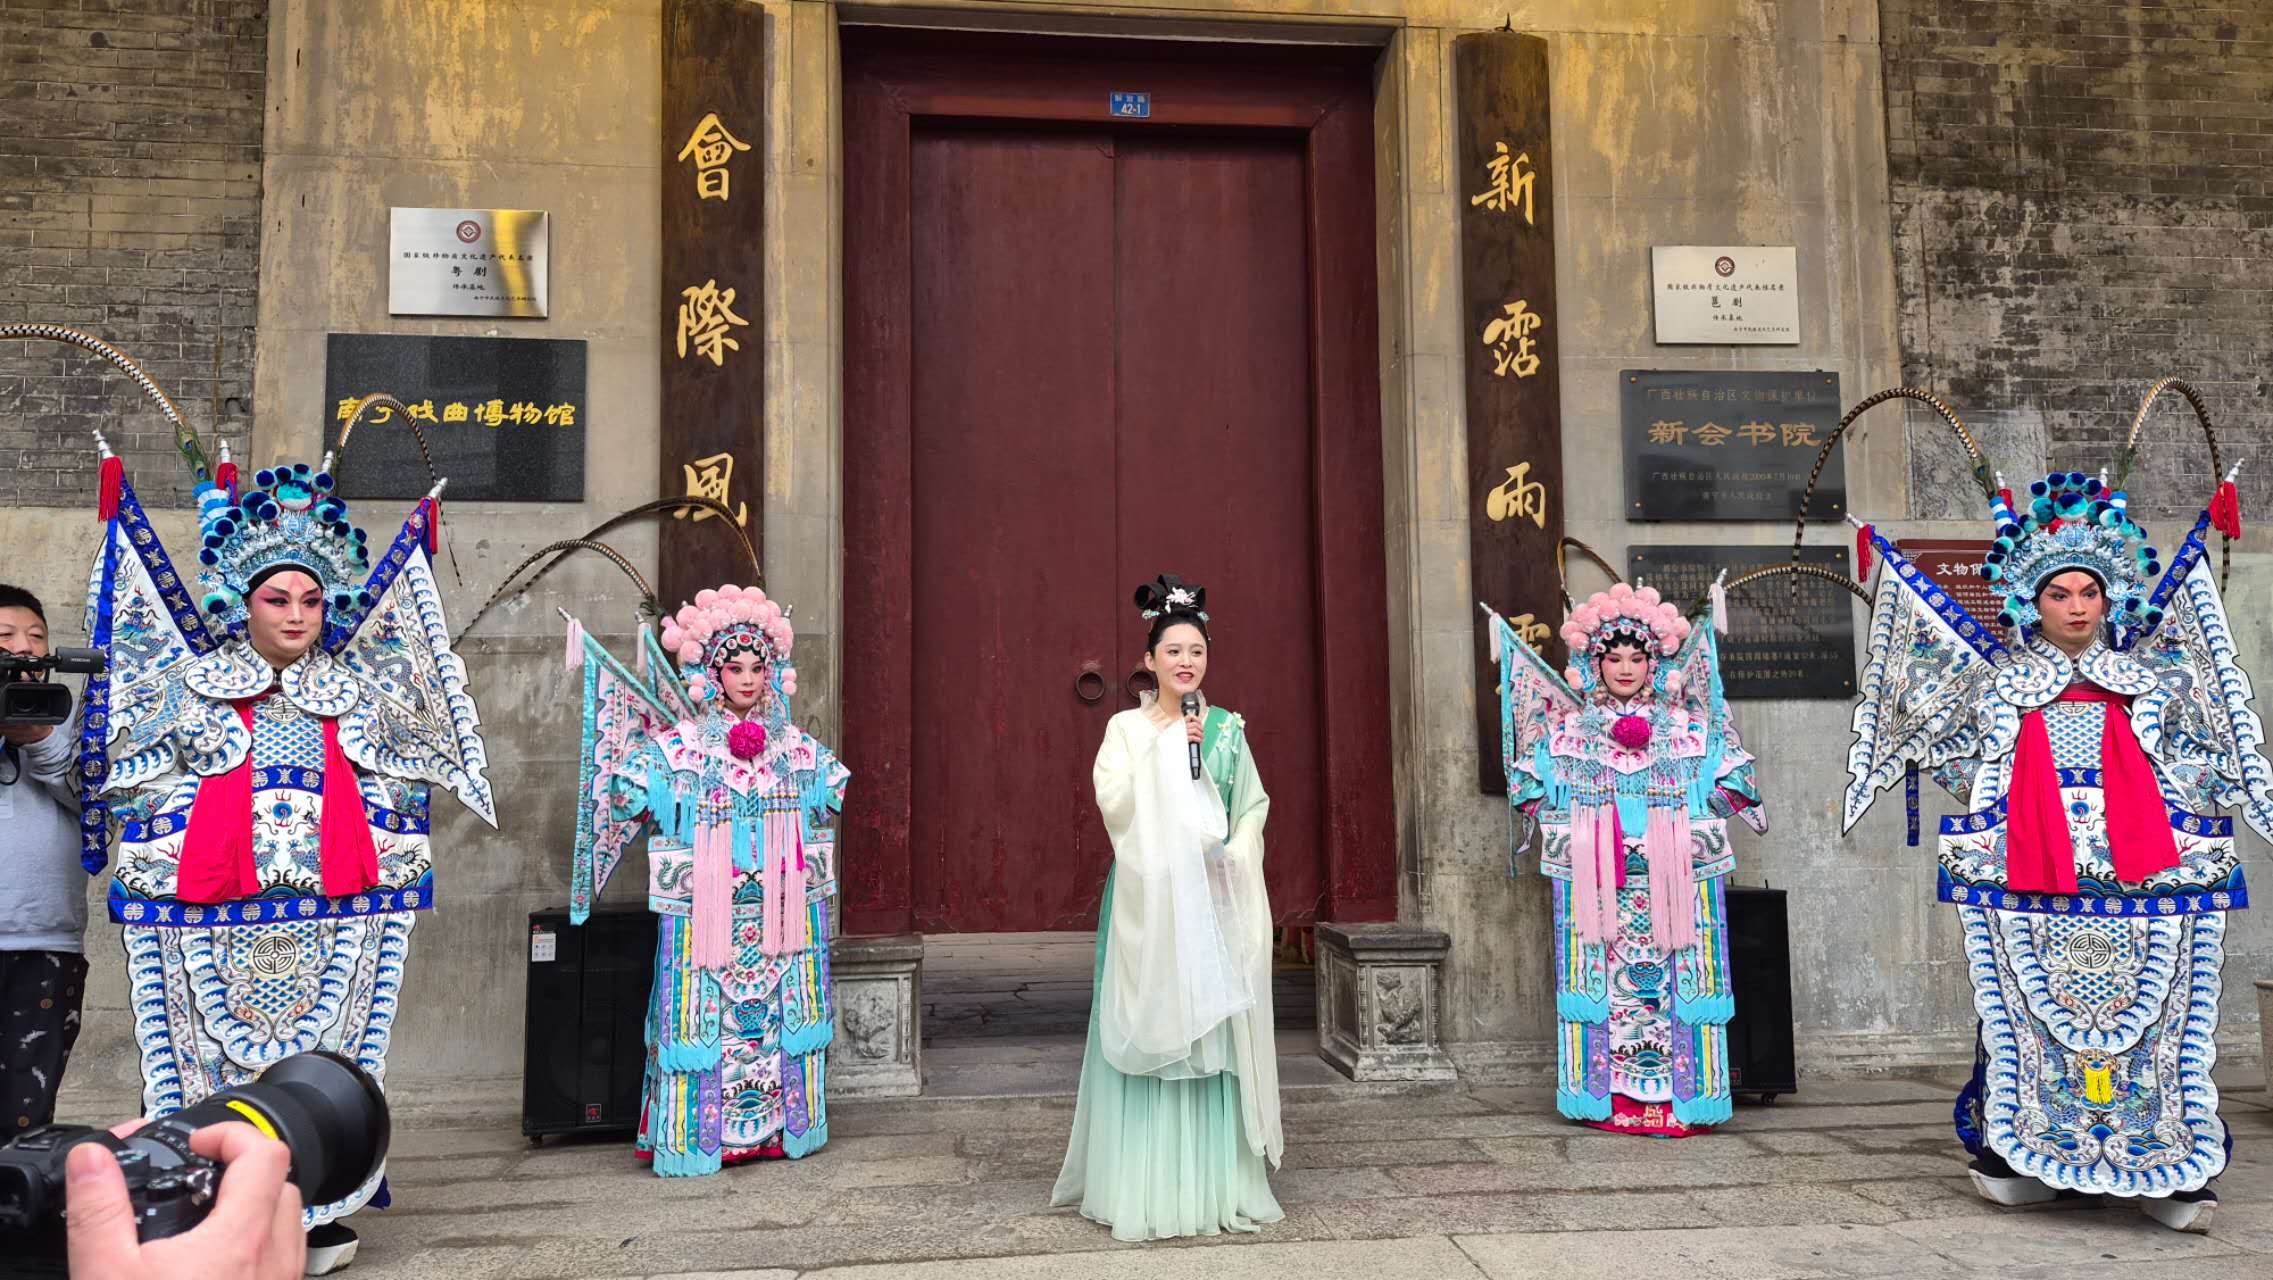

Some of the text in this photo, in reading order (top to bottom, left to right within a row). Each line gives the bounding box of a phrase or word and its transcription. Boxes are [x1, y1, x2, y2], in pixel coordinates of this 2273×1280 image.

[1121, 103, 1141, 115] 42-1
[450, 265, 488, 278] 粤剧
[1647, 419, 1823, 448] 新会书院
